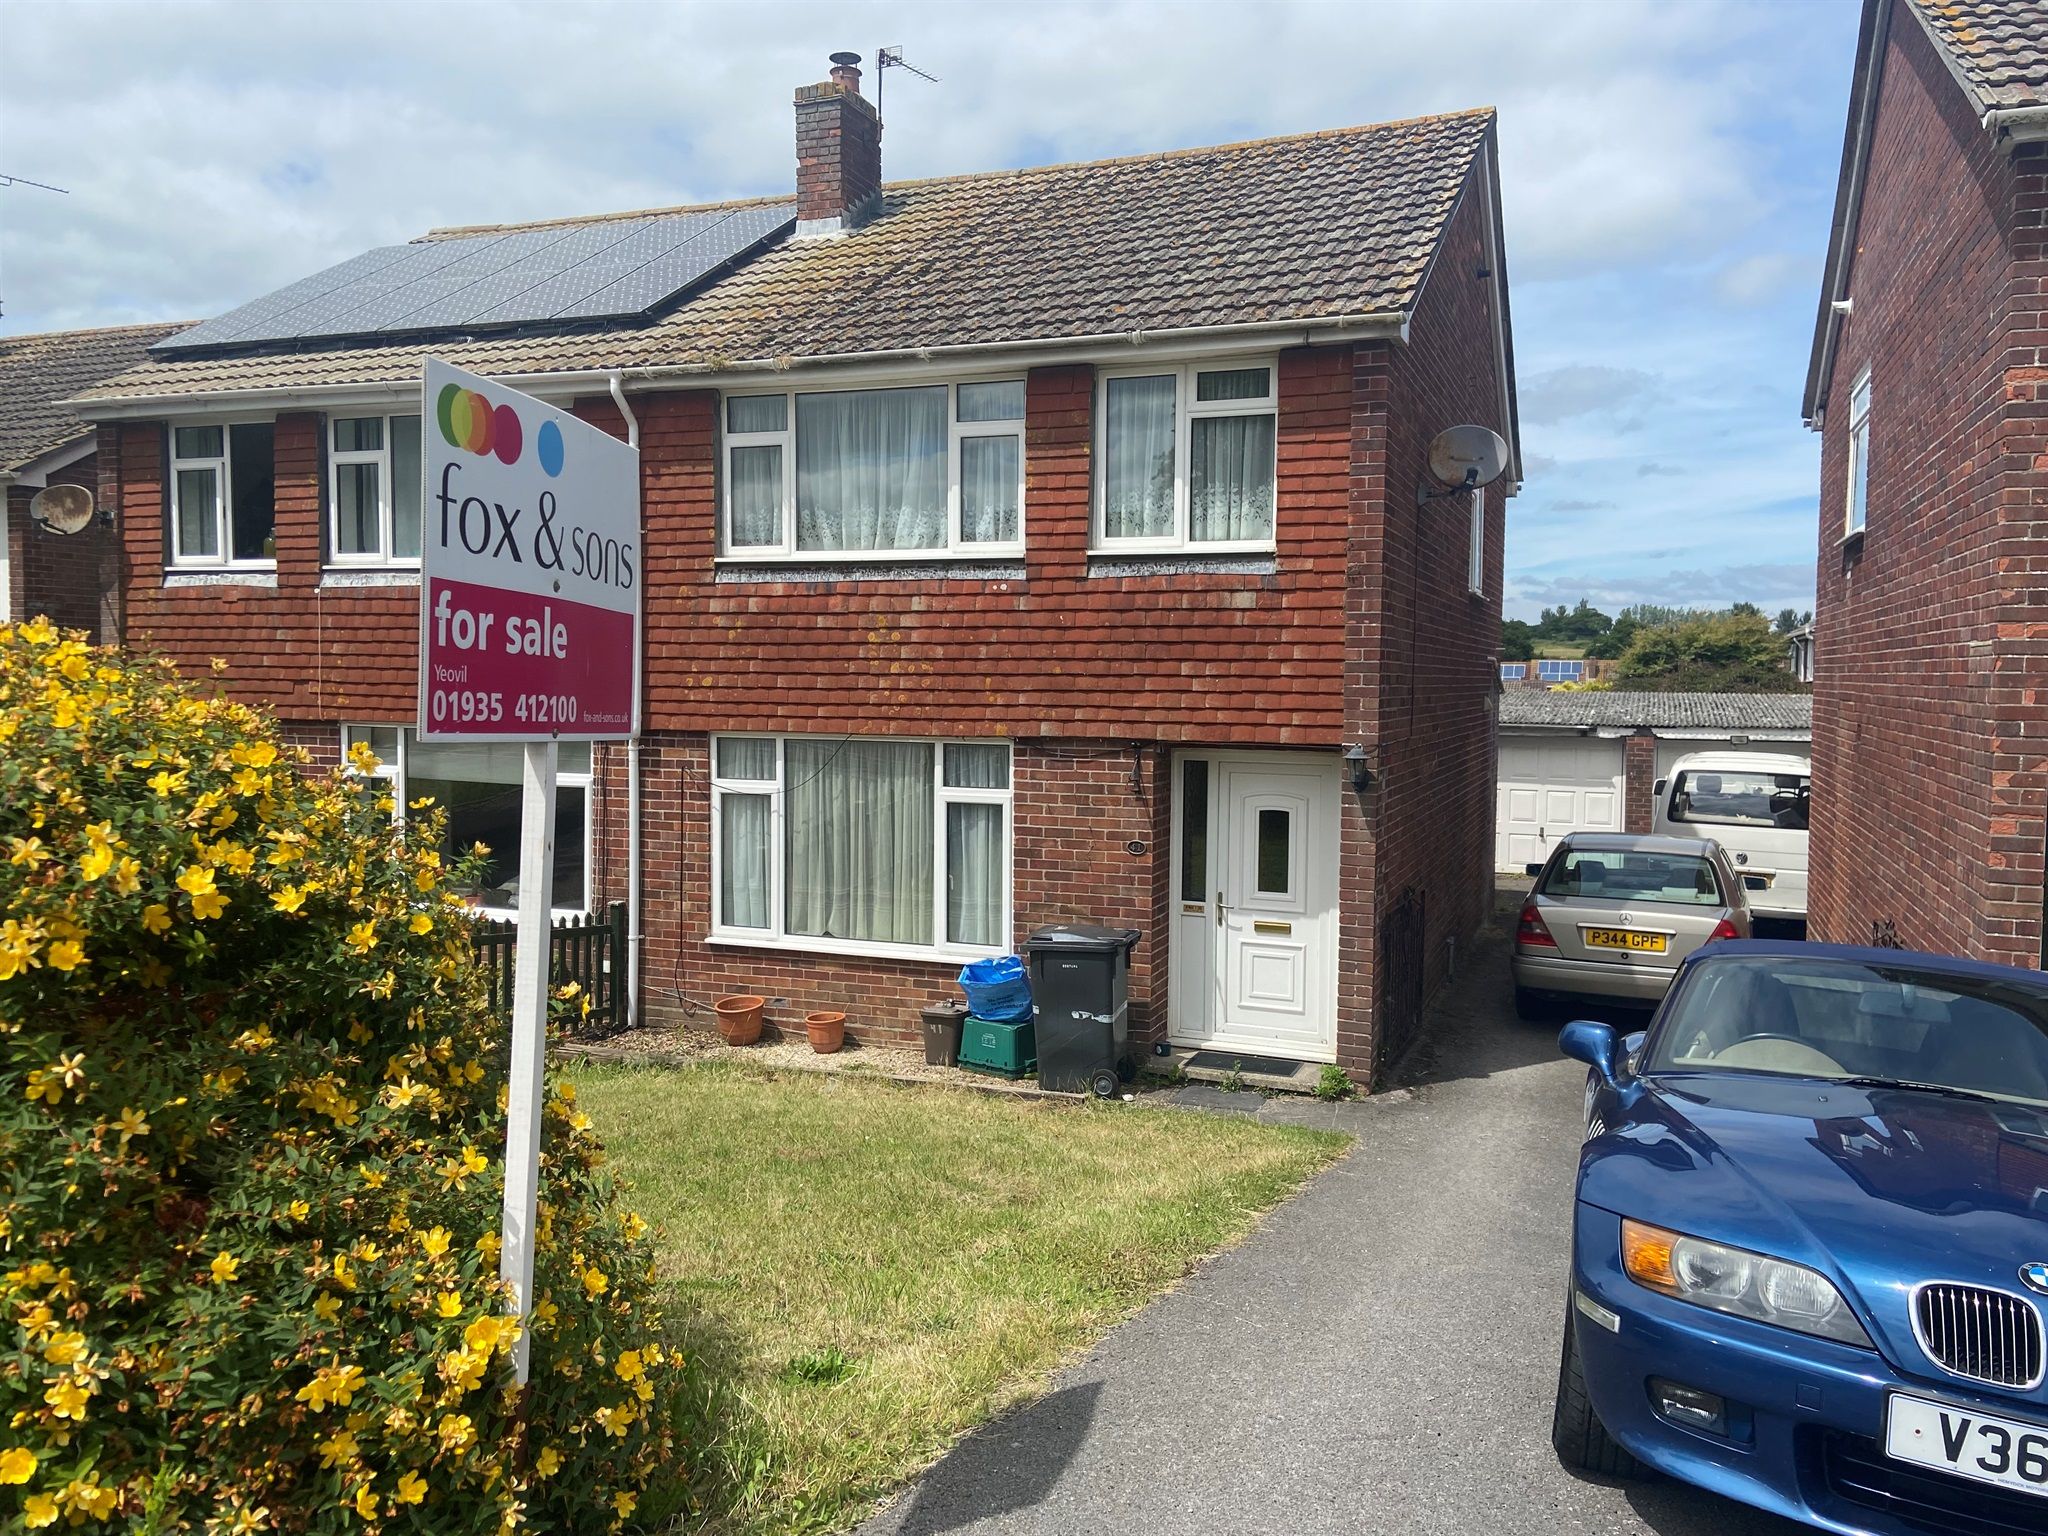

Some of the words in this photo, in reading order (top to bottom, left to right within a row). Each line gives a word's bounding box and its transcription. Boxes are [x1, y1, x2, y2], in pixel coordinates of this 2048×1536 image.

[436, 462, 522, 563] fox
[534, 491, 564, 571] &
[572, 526, 633, 590] sons
[434, 590, 494, 651] for
[505, 606, 568, 659] sale
[434, 664, 467, 682] Yeovil
[433, 690, 503, 721] 01935
[515, 694, 577, 722] 412100
[583, 710, 629, 722] fox-and-sons.co.uk
[1592, 931, 1627, 946] P344
[1631, 935, 1659, 947] GPF
[1939, 1411, 2048, 1484] V36
